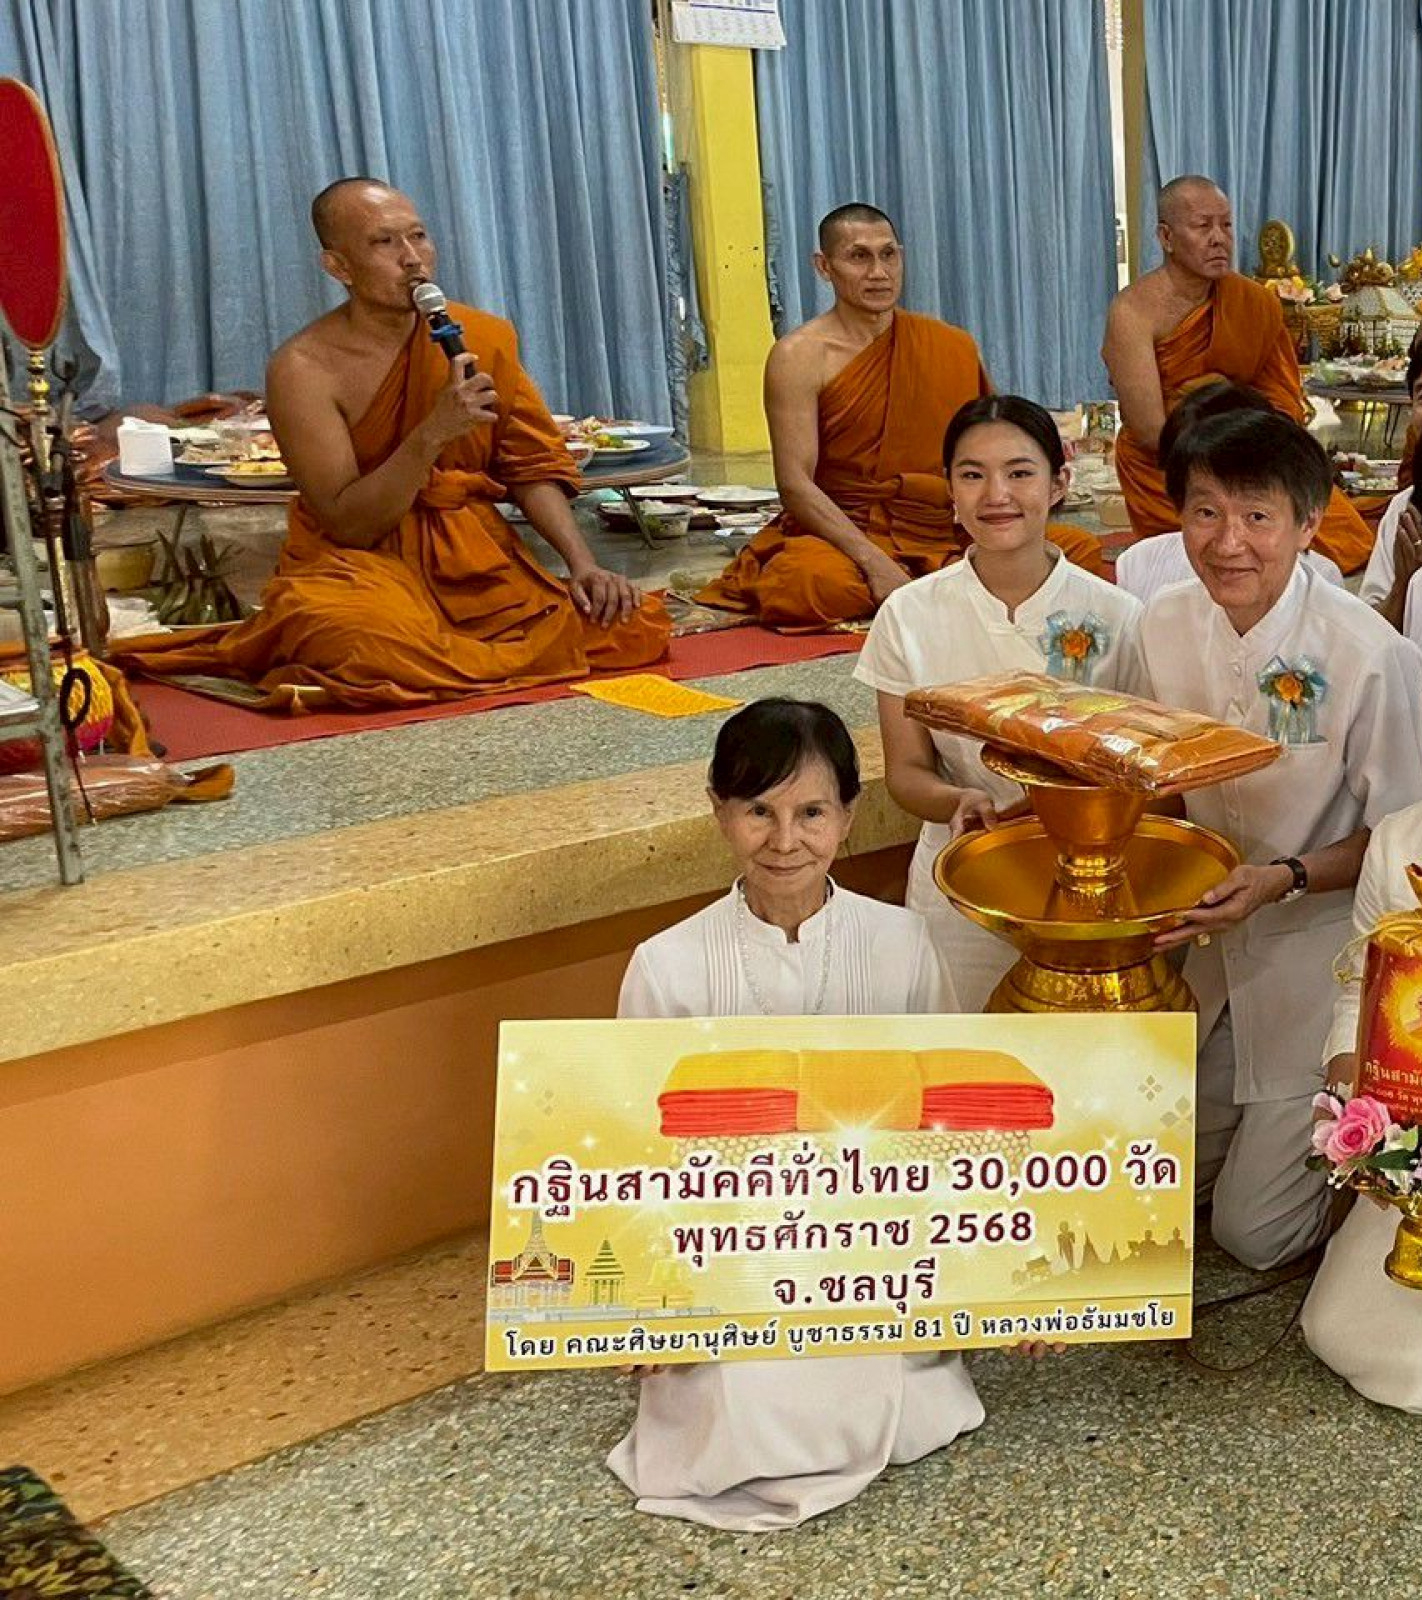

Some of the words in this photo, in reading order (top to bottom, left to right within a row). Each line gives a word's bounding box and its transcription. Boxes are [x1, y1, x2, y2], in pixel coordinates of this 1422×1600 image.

[513, 1141, 930, 1217] กฐินสามัคคีทั่วไทย
[952, 1155, 1107, 1196] 30,000
[1125, 1143, 1177, 1185] วัด
[674, 1210, 910, 1267] พุทธศักราช
[930, 1212, 1032, 1244] 2568
[773, 1258, 936, 1314] จ.ชลบุรี
[506, 1331, 555, 1357] โดย
[566, 1320, 777, 1356] คณะศิษยานุศิษย์
[788, 1323, 903, 1352] บูชาธรรม
[914, 1322, 942, 1338] 81
[953, 1312, 971, 1336] ปี
[981, 1303, 1174, 1336] หลวงพ่อธัมมชโย
